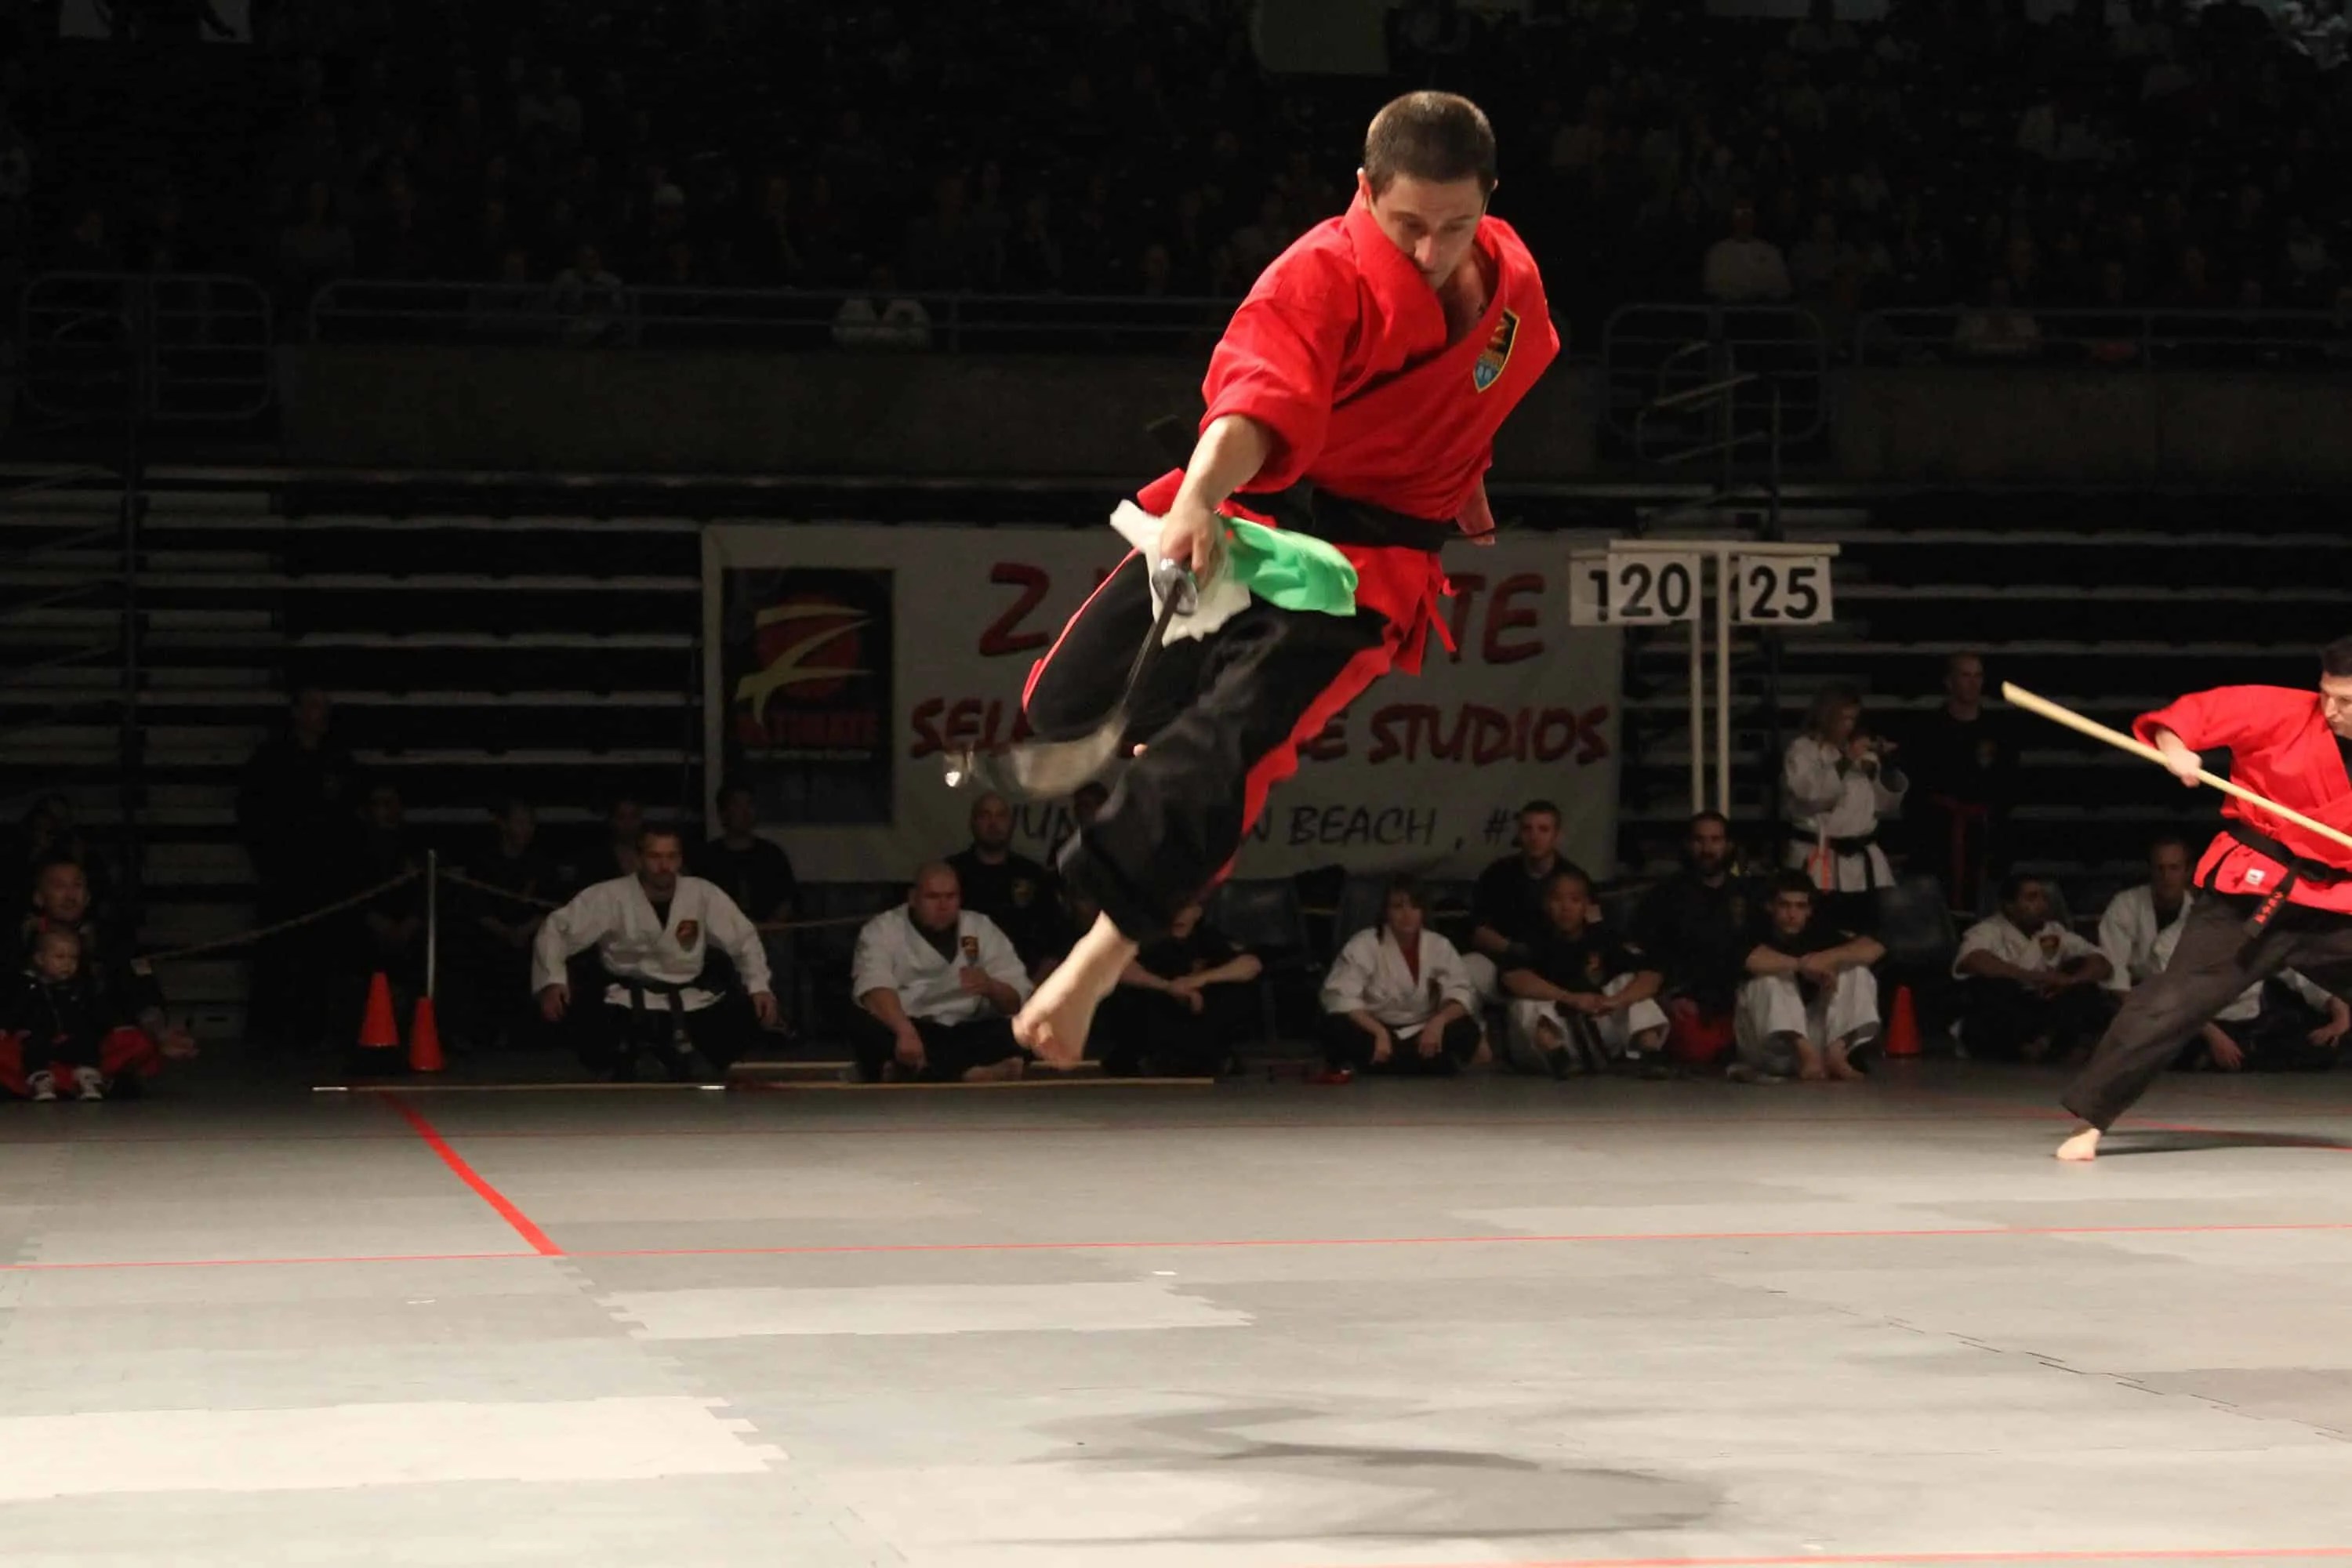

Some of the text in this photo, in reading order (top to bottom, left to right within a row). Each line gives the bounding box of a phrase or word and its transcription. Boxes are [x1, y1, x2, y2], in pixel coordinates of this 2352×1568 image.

[1749, 565, 1818, 619] 25
[1369, 703, 1610, 766] STUDIOS
[1288, 805, 1436, 849] BEACH
